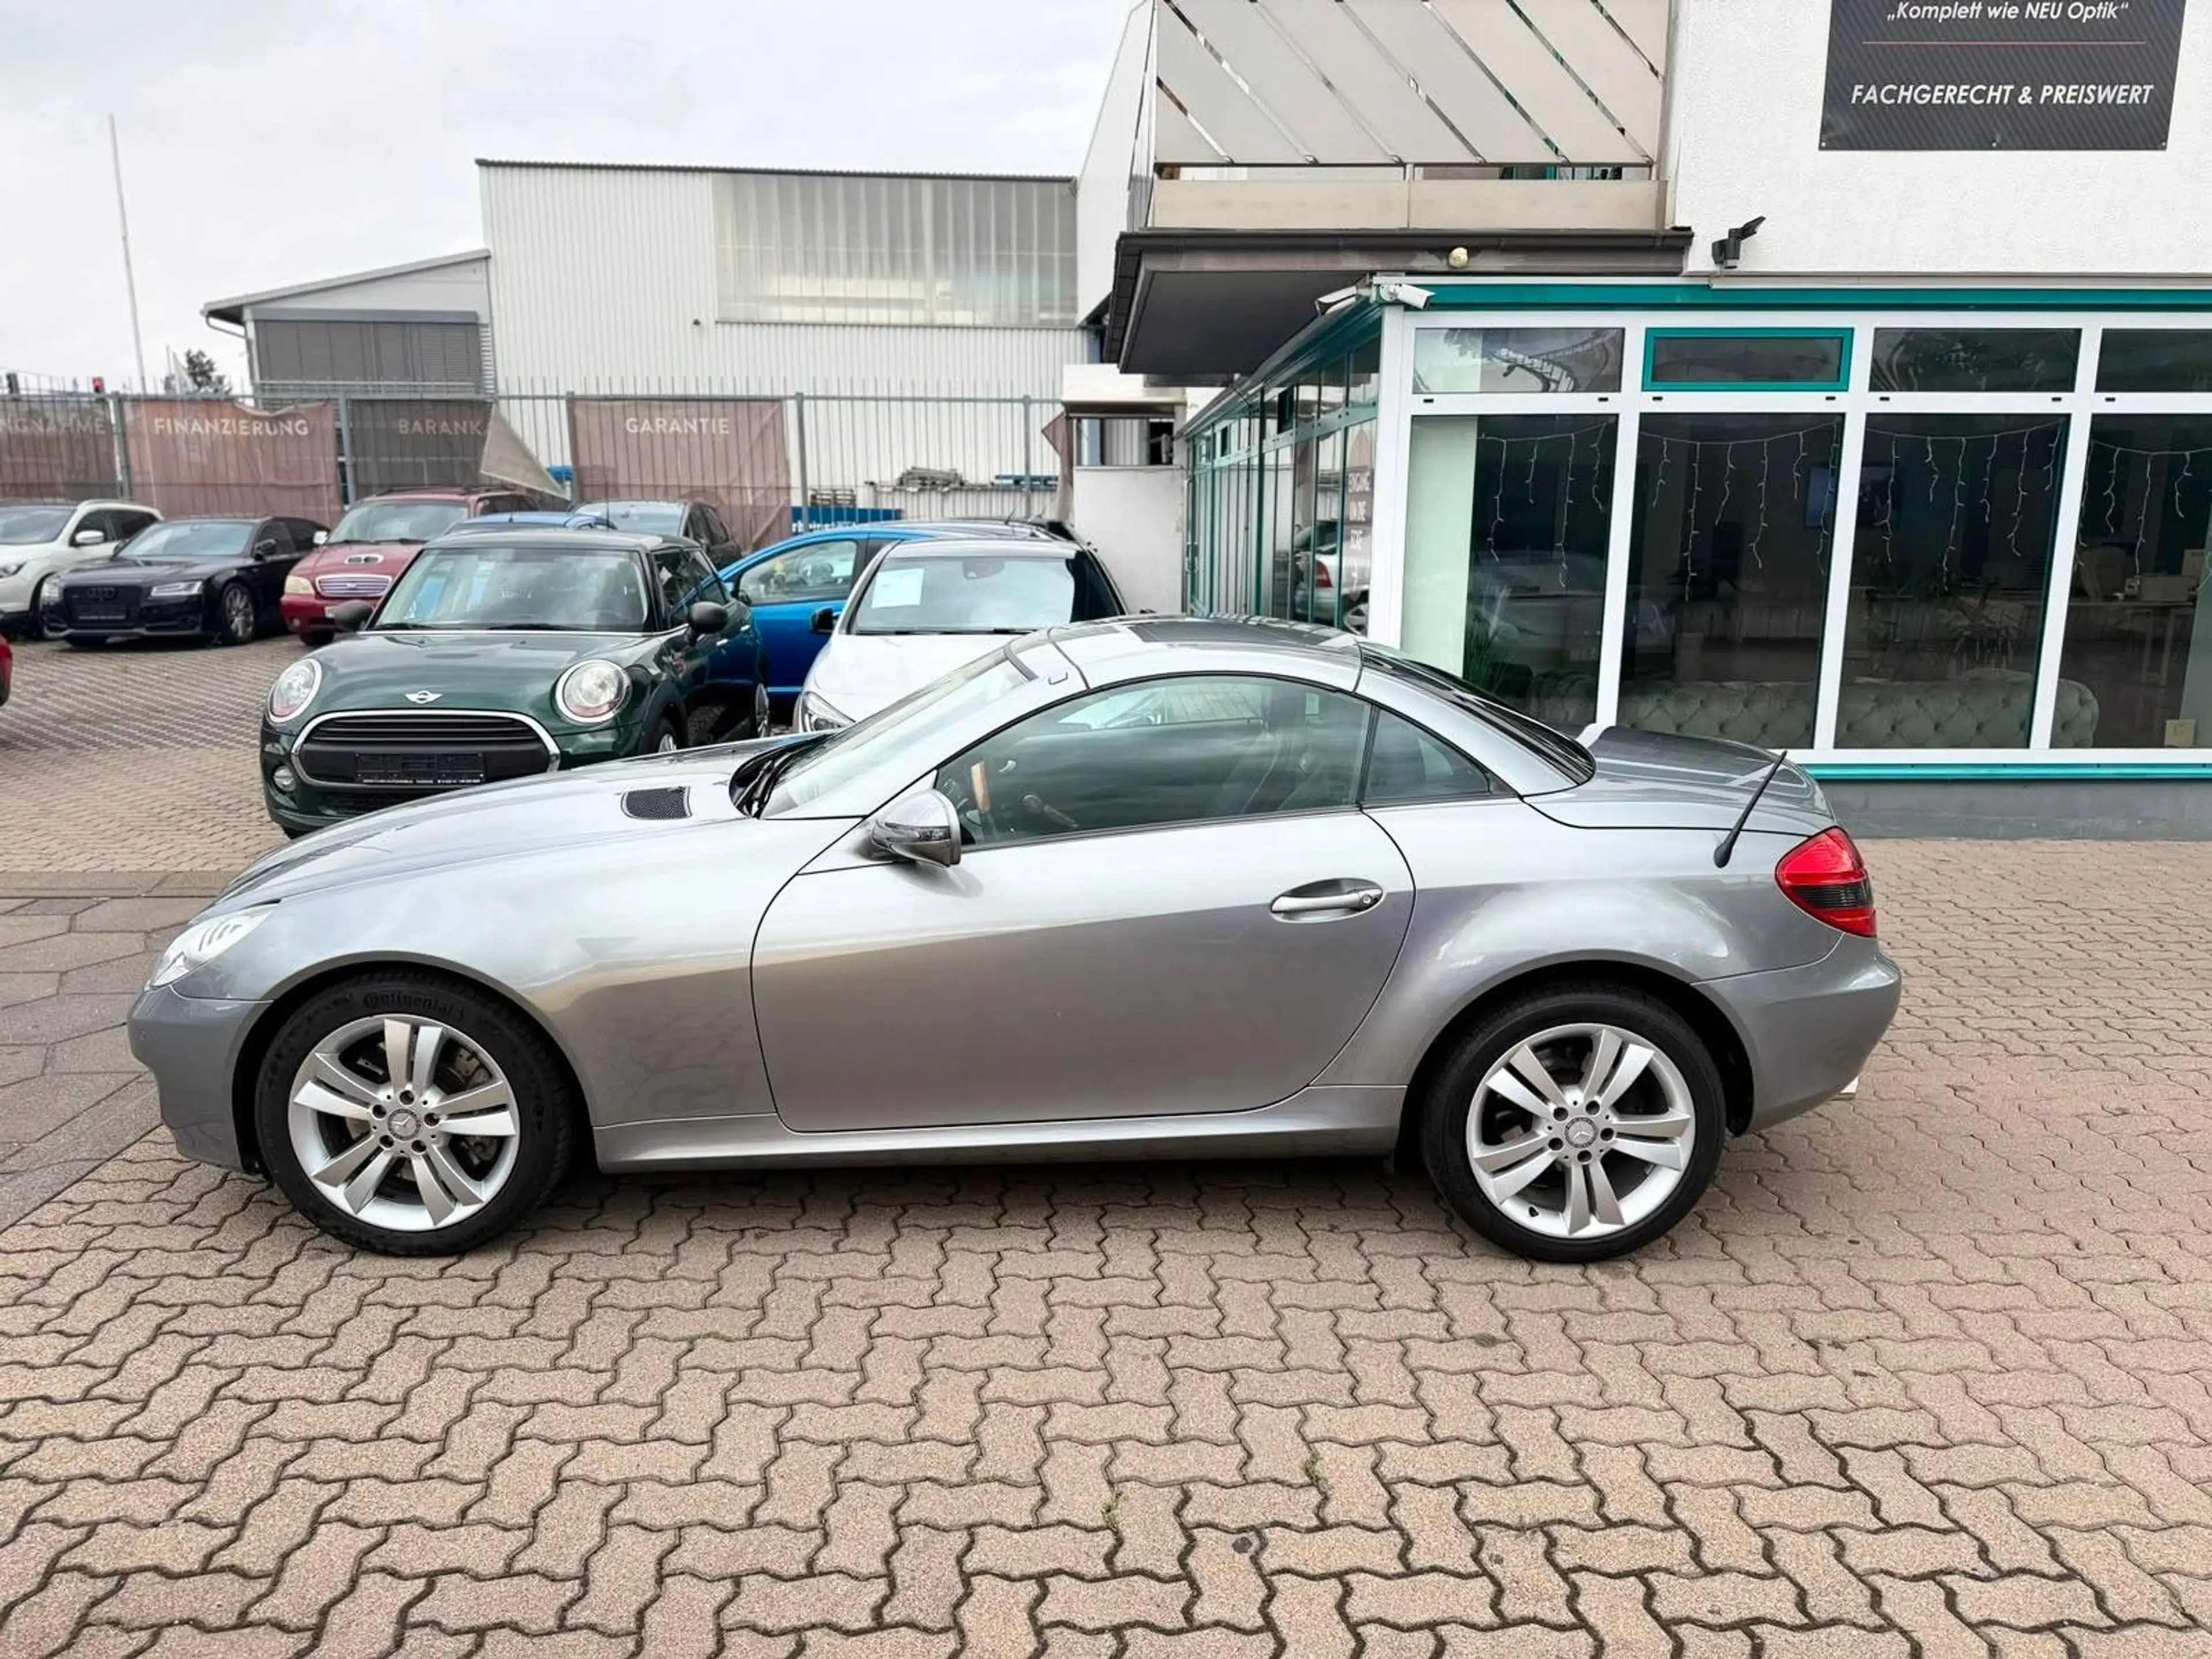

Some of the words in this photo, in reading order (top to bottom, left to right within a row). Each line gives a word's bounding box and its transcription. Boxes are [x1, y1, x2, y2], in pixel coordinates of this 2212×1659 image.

[1987, 3, 2019, 19] wie
[2025, 3, 2062, 19] NEU
[1850, 84, 2014, 105] FACHGERECHT
[2017, 84, 2033, 104] &
[2039, 84, 2154, 105] PREISWERT
[154, 417, 309, 436] FINANZIERUNG
[398, 417, 488, 435] BARANK
[624, 416, 730, 435] GARANTIE
